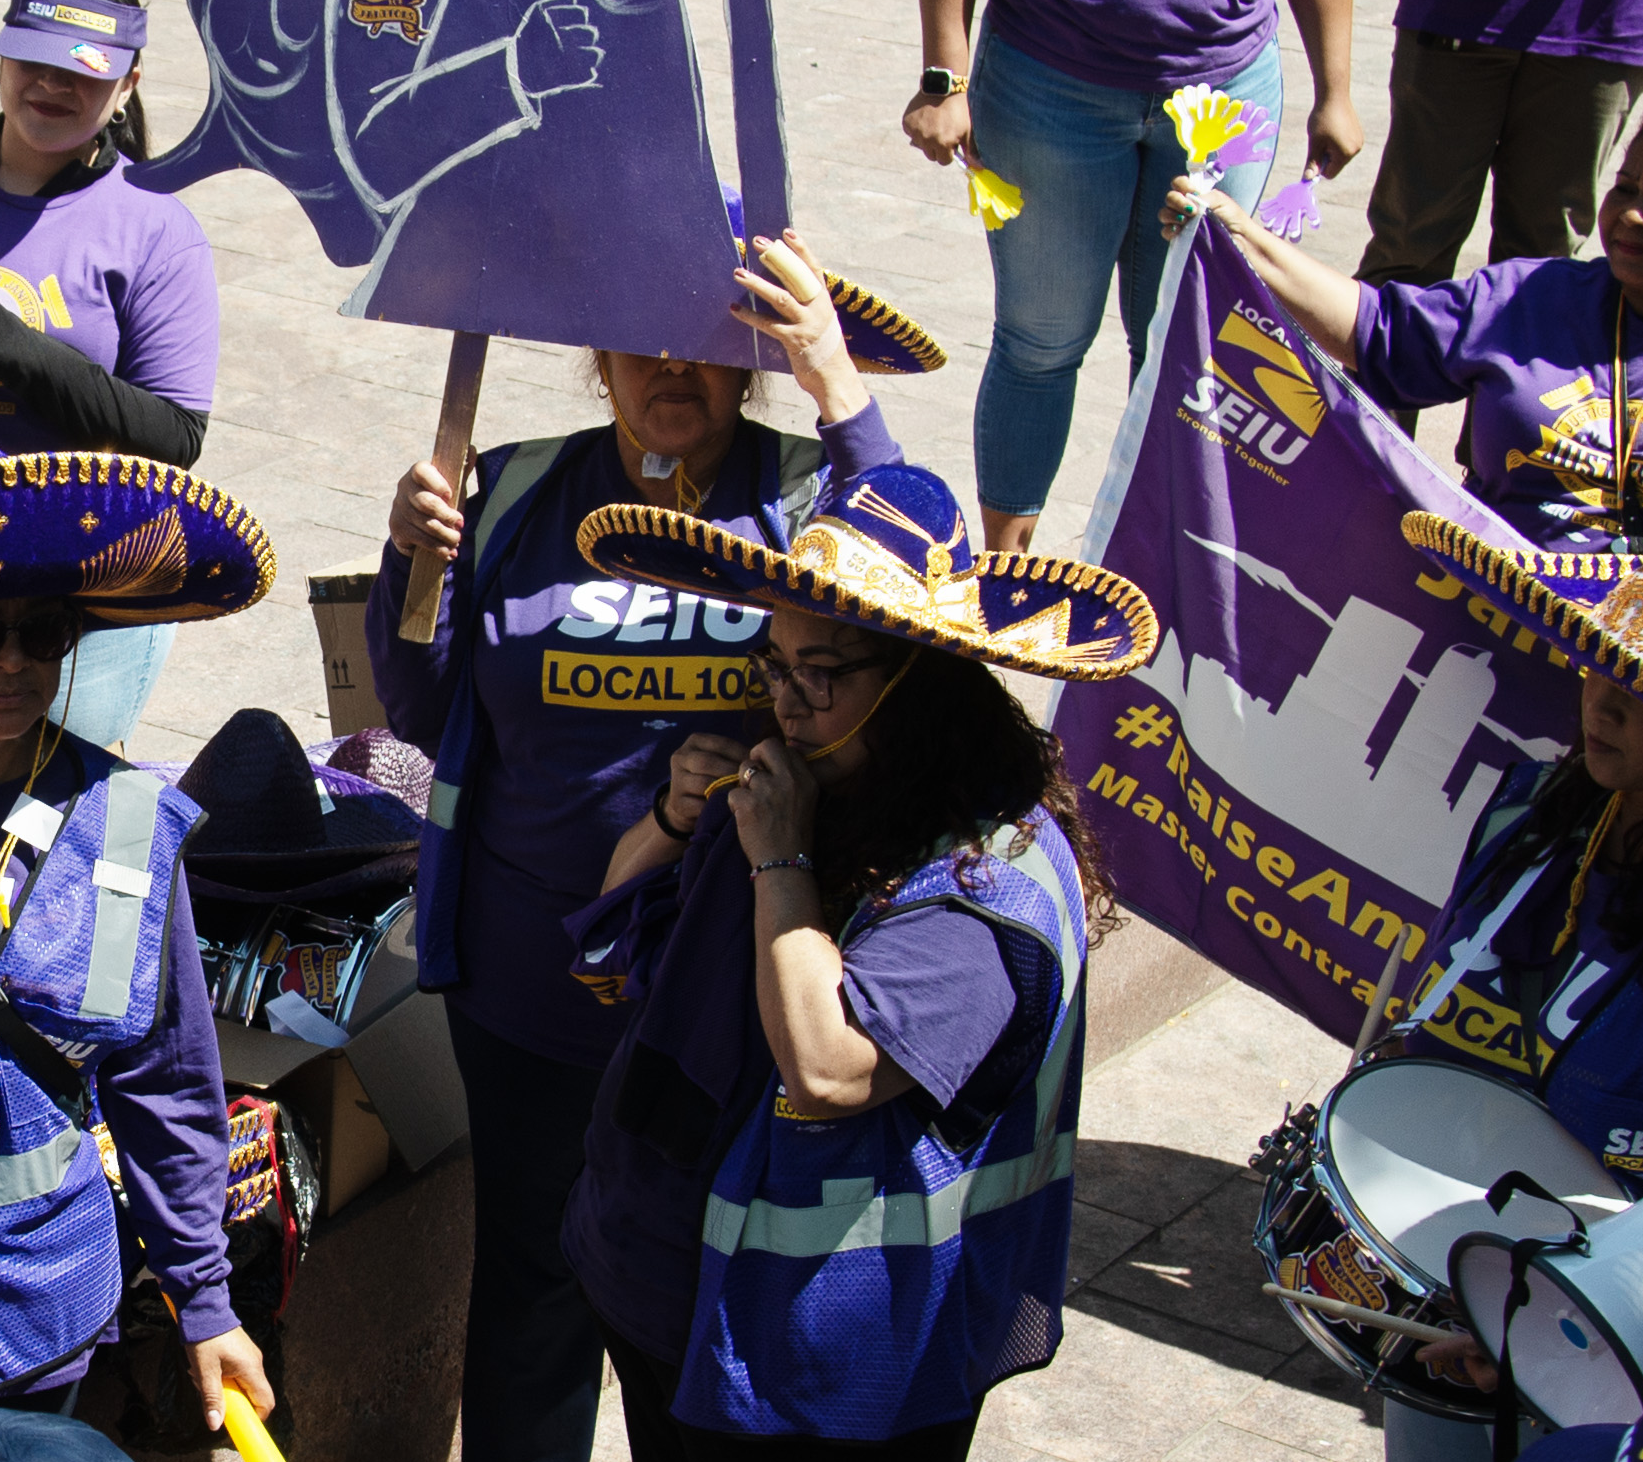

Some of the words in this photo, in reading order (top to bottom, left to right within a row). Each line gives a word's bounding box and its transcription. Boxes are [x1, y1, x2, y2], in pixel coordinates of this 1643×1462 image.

[27, 1, 55, 18] SEIU
[57, 8, 94, 27] LOCAL
[3, 275, 43, 328] JANITOR
[1232, 299, 1297, 346] LOCA
[1175, 405, 1230, 458] Stronger
[1231, 441, 1291, 490] Together
[1182, 376, 1311, 466] SEIU
[560, 580, 773, 643] SEIU
[548, 656, 684, 704] LOCAL
[1086, 762, 1218, 886] Master
